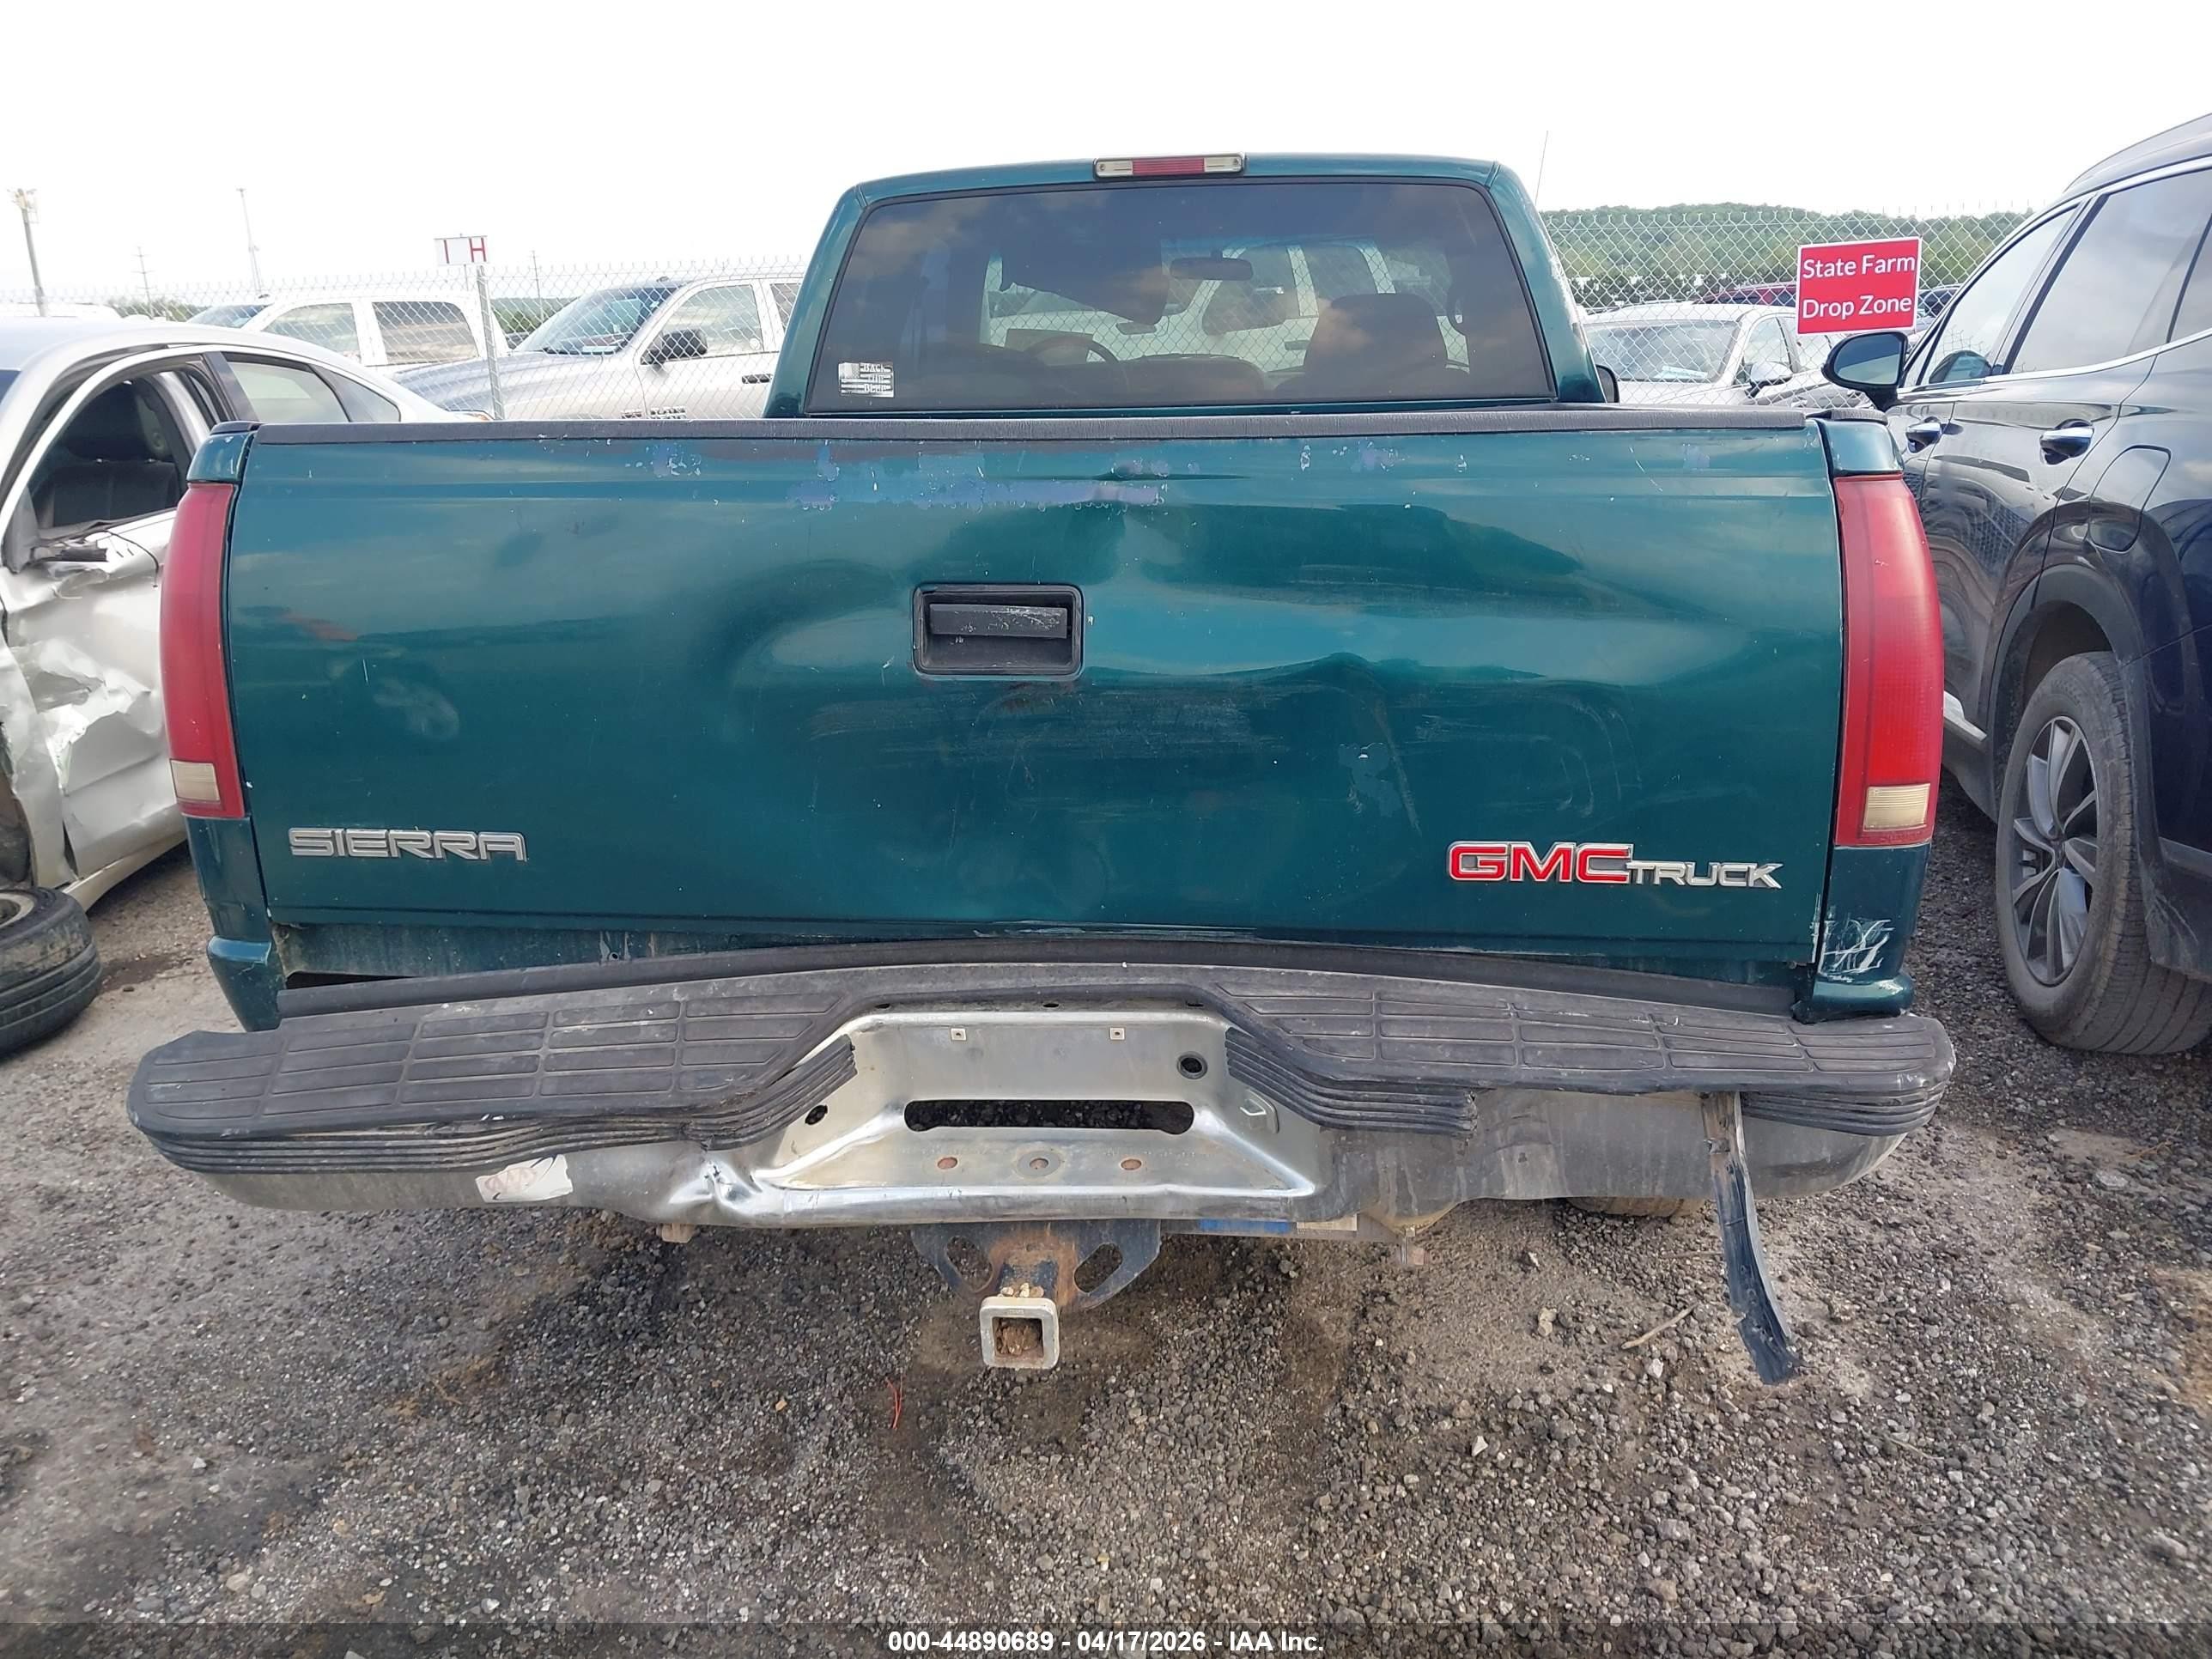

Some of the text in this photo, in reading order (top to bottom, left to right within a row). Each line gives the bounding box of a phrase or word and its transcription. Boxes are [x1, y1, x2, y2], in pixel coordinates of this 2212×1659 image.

[468, 237, 487, 263] H
[1802, 254, 1916, 279] State Farm
[1802, 295, 1912, 320] Drop Zone
[864, 363, 885, 373] BACK
[289, 828, 527, 861] SIERRA
[1448, 841, 1784, 889] GMC TRUCK
